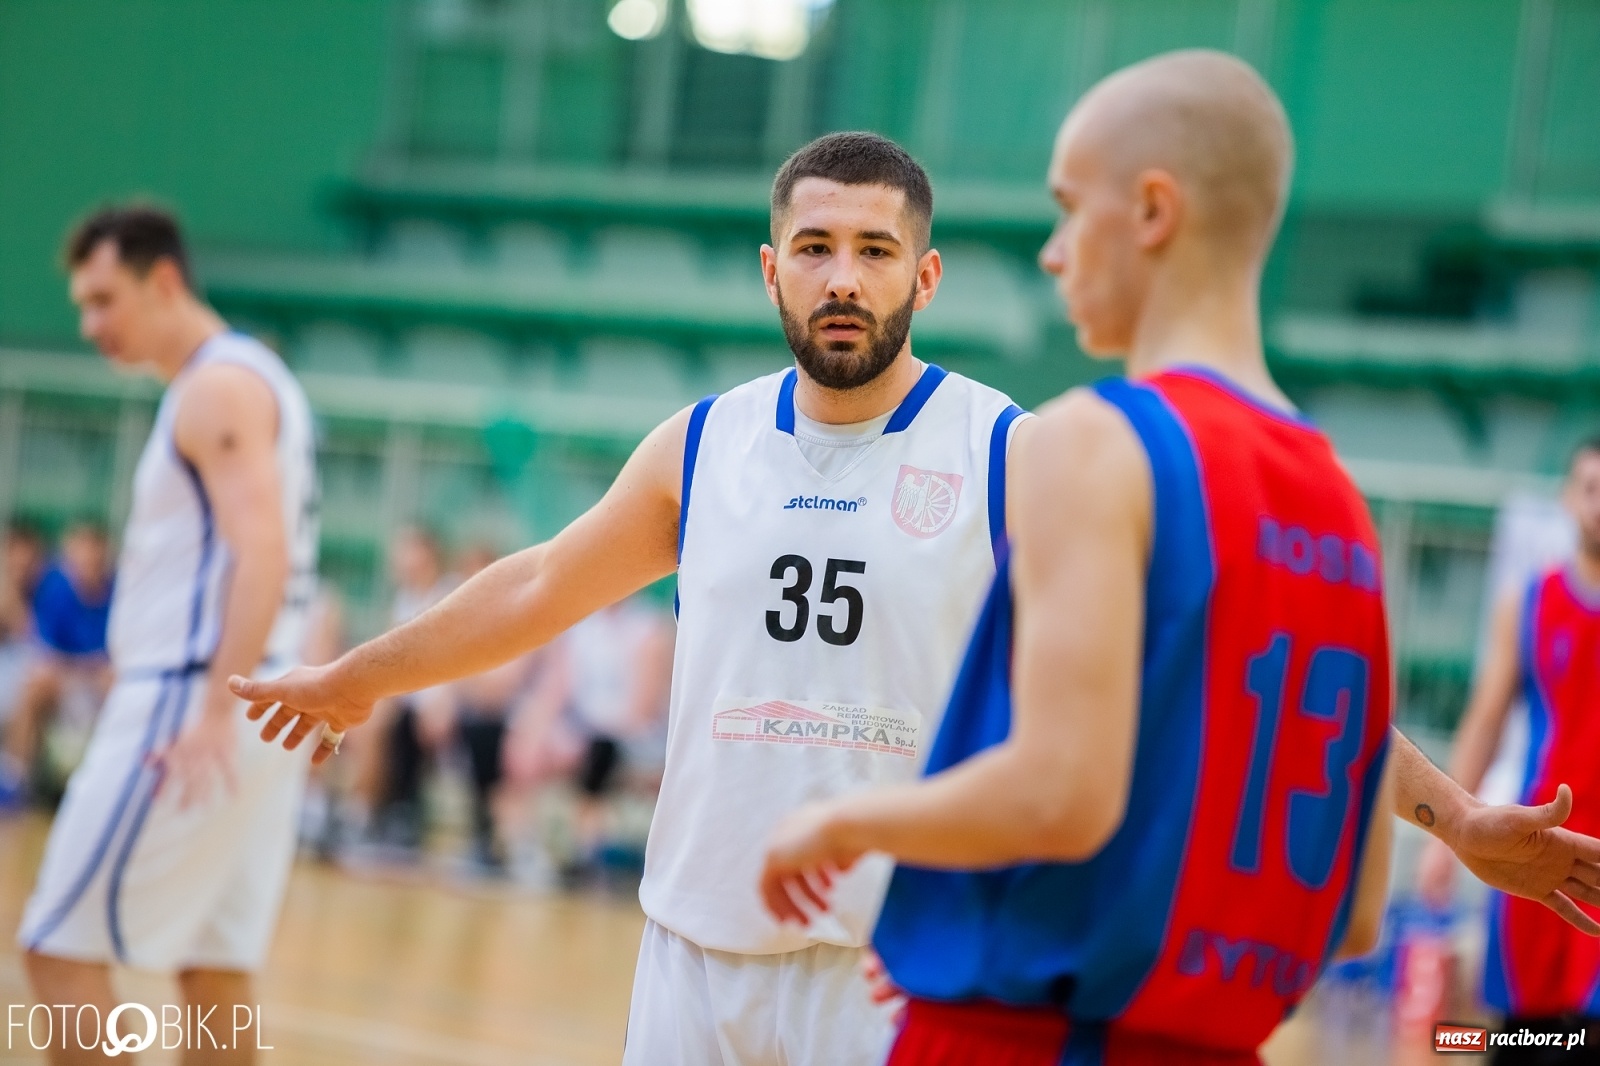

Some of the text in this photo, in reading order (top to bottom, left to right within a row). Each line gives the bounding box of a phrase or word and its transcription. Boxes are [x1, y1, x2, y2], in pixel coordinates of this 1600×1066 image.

[765, 554, 866, 646] 35
[822, 704, 867, 713] ZAKŁAD
[836, 712, 905, 726] REMONTOWO
[763, 718, 891, 745] KAMPKA
[1228, 631, 1371, 891] 13
